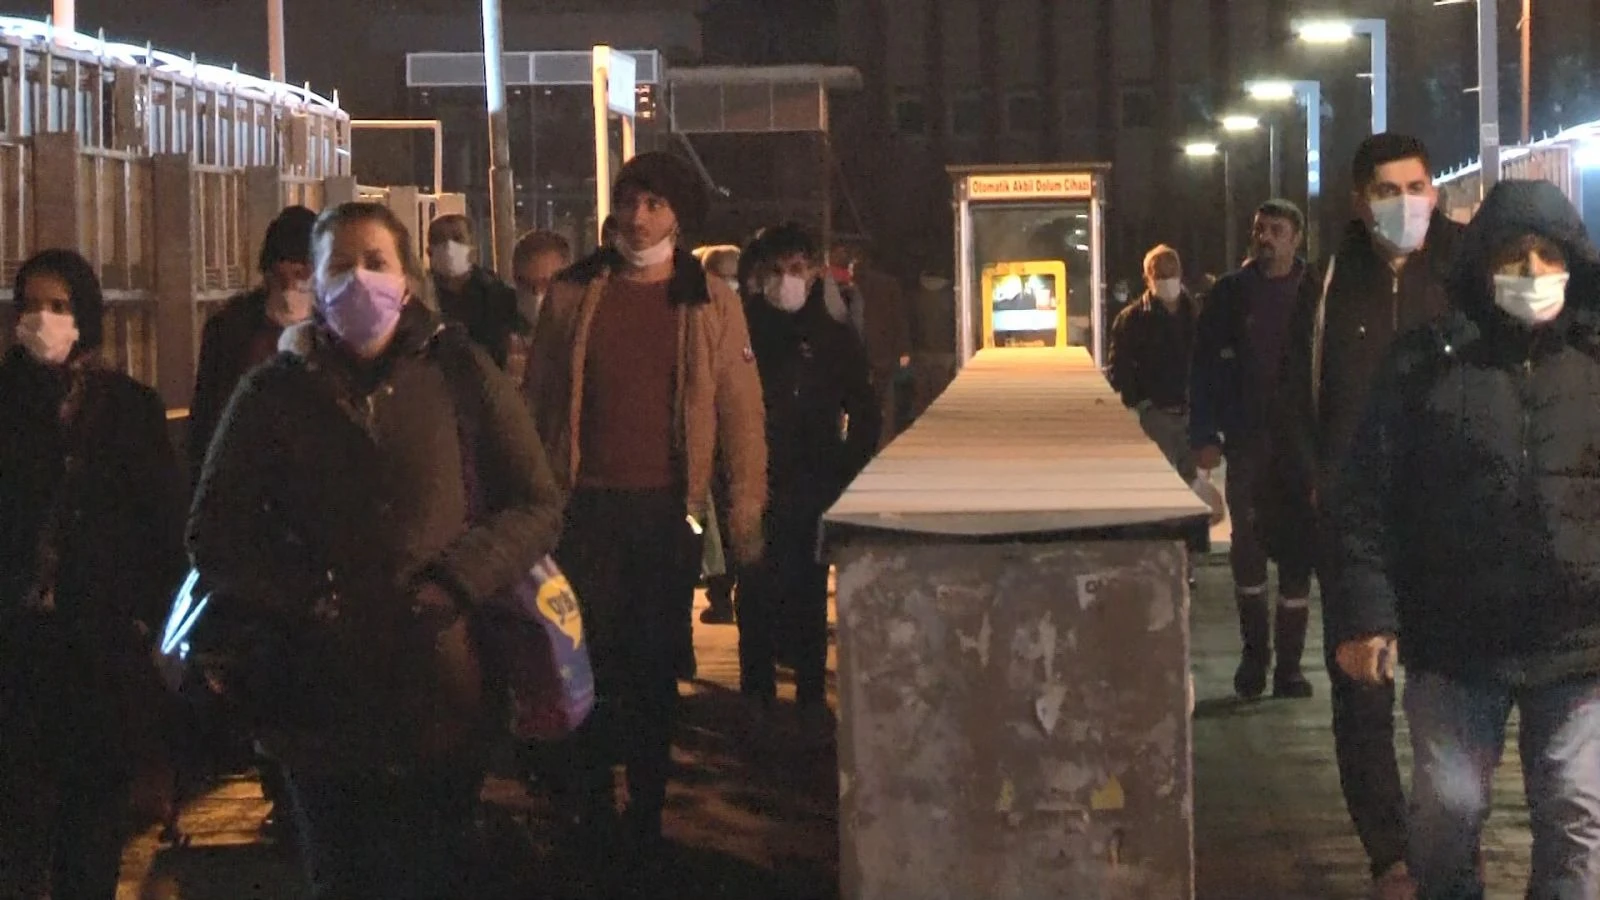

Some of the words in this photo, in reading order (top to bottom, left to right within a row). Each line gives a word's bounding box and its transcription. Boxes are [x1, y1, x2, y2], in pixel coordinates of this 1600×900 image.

[972, 180, 1009, 193] Otomatik
[1013, 179, 1034, 192] Akbil
[1036, 179, 1062, 192] Dolum
